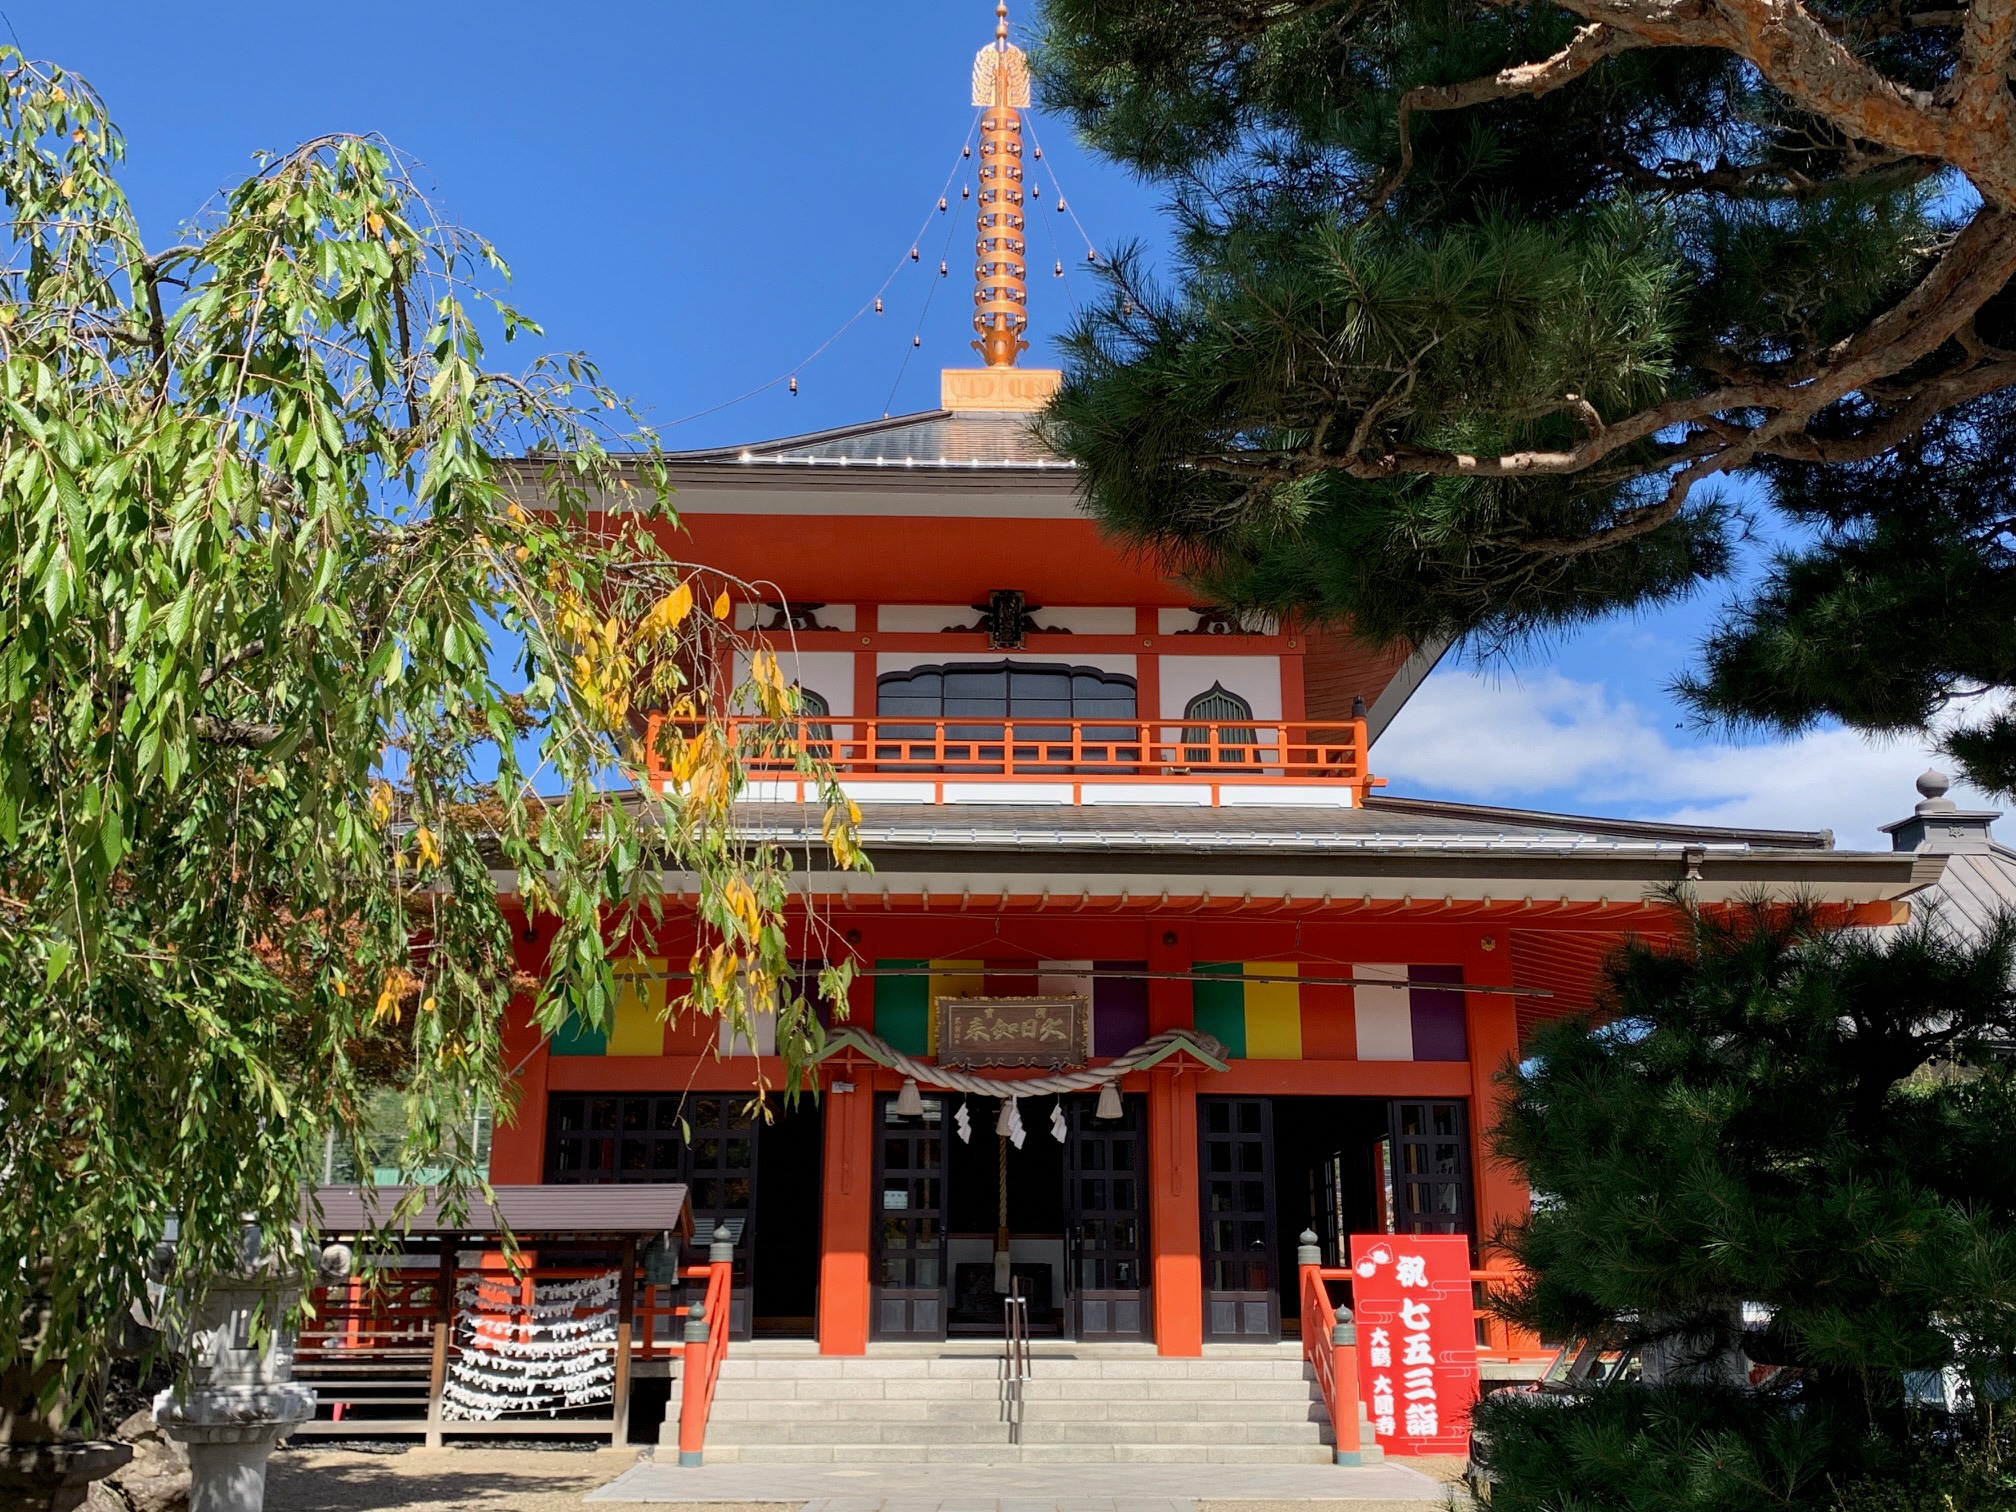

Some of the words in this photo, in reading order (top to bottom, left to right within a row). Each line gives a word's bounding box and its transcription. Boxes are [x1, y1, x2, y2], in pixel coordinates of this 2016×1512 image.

[1396, 1255, 1429, 1287] 祝
[1398, 1298, 1438, 1436] 七五三詣
